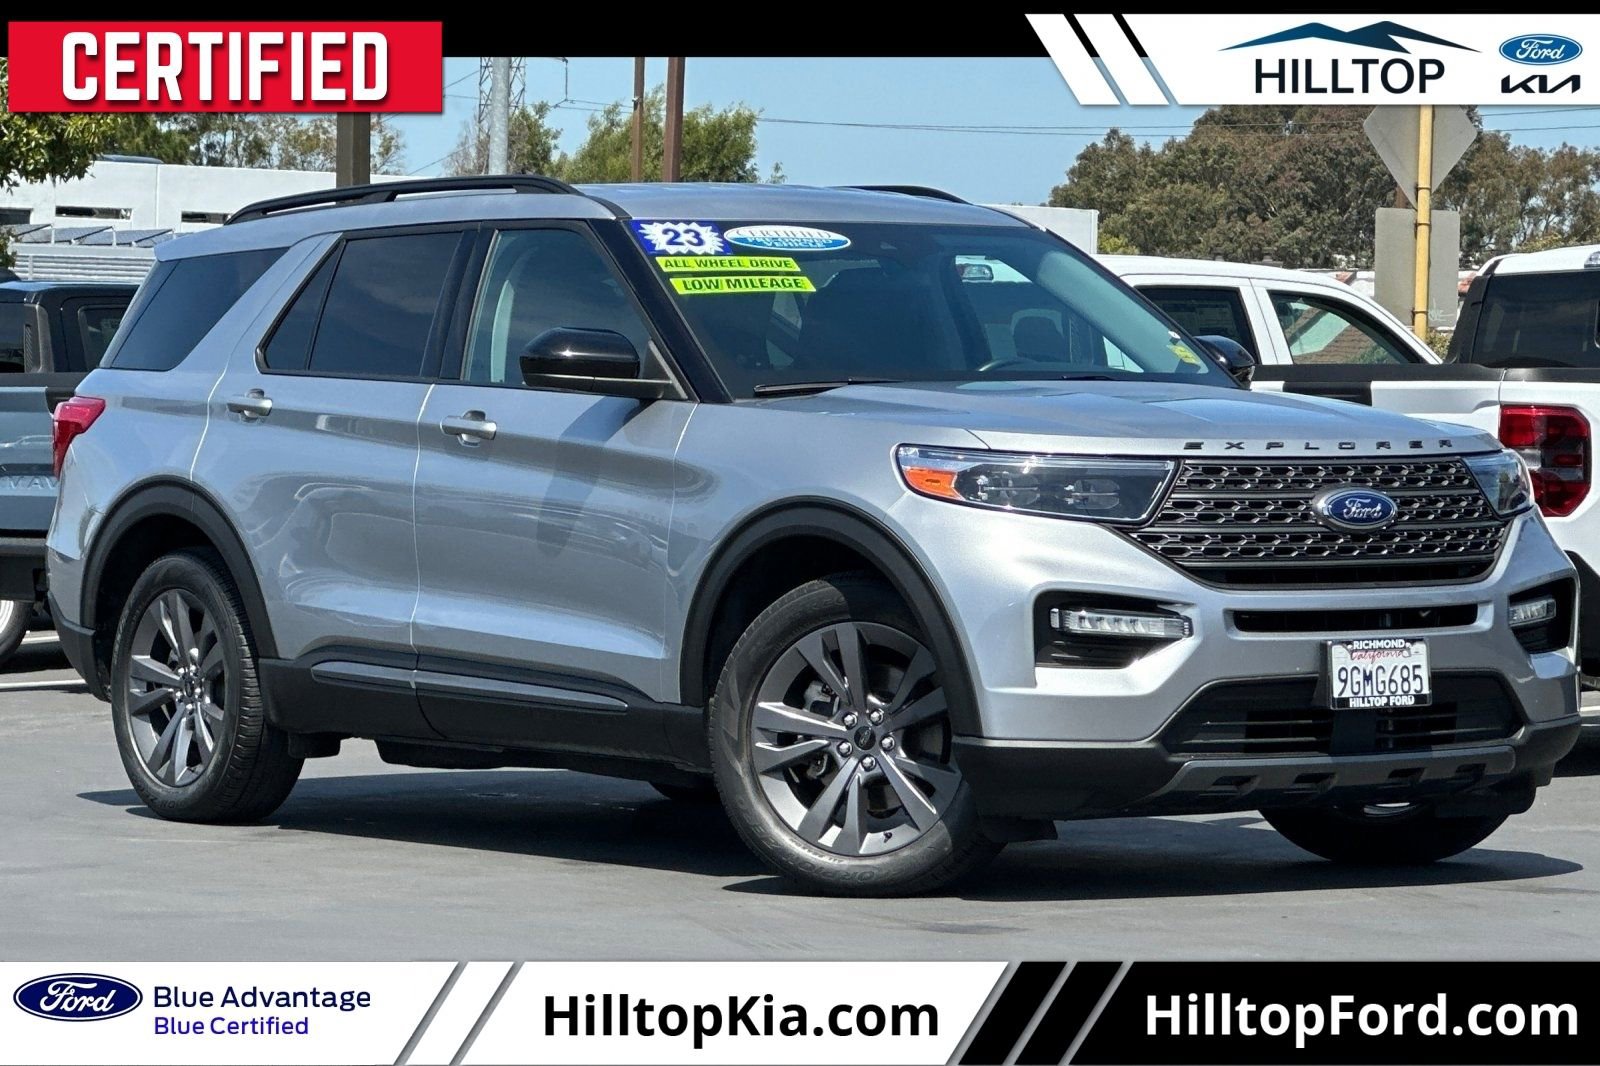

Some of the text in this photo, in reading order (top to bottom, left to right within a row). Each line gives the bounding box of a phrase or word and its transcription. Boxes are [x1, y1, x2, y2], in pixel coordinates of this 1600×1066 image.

[661, 228, 706, 247] 23
[664, 258, 793, 269] ALL WHEEL DRIVE
[682, 278, 803, 291] LOW MILEAGE
[1183, 438, 1453, 450] EXPLORER
[1343, 497, 1382, 519] Ford
[1353, 639, 1406, 650] RICHMOND
[1351, 649, 1405, 664] California
[1337, 664, 1424, 697] 9GMG685
[1349, 695, 1415, 708] HILLTOP FORD
